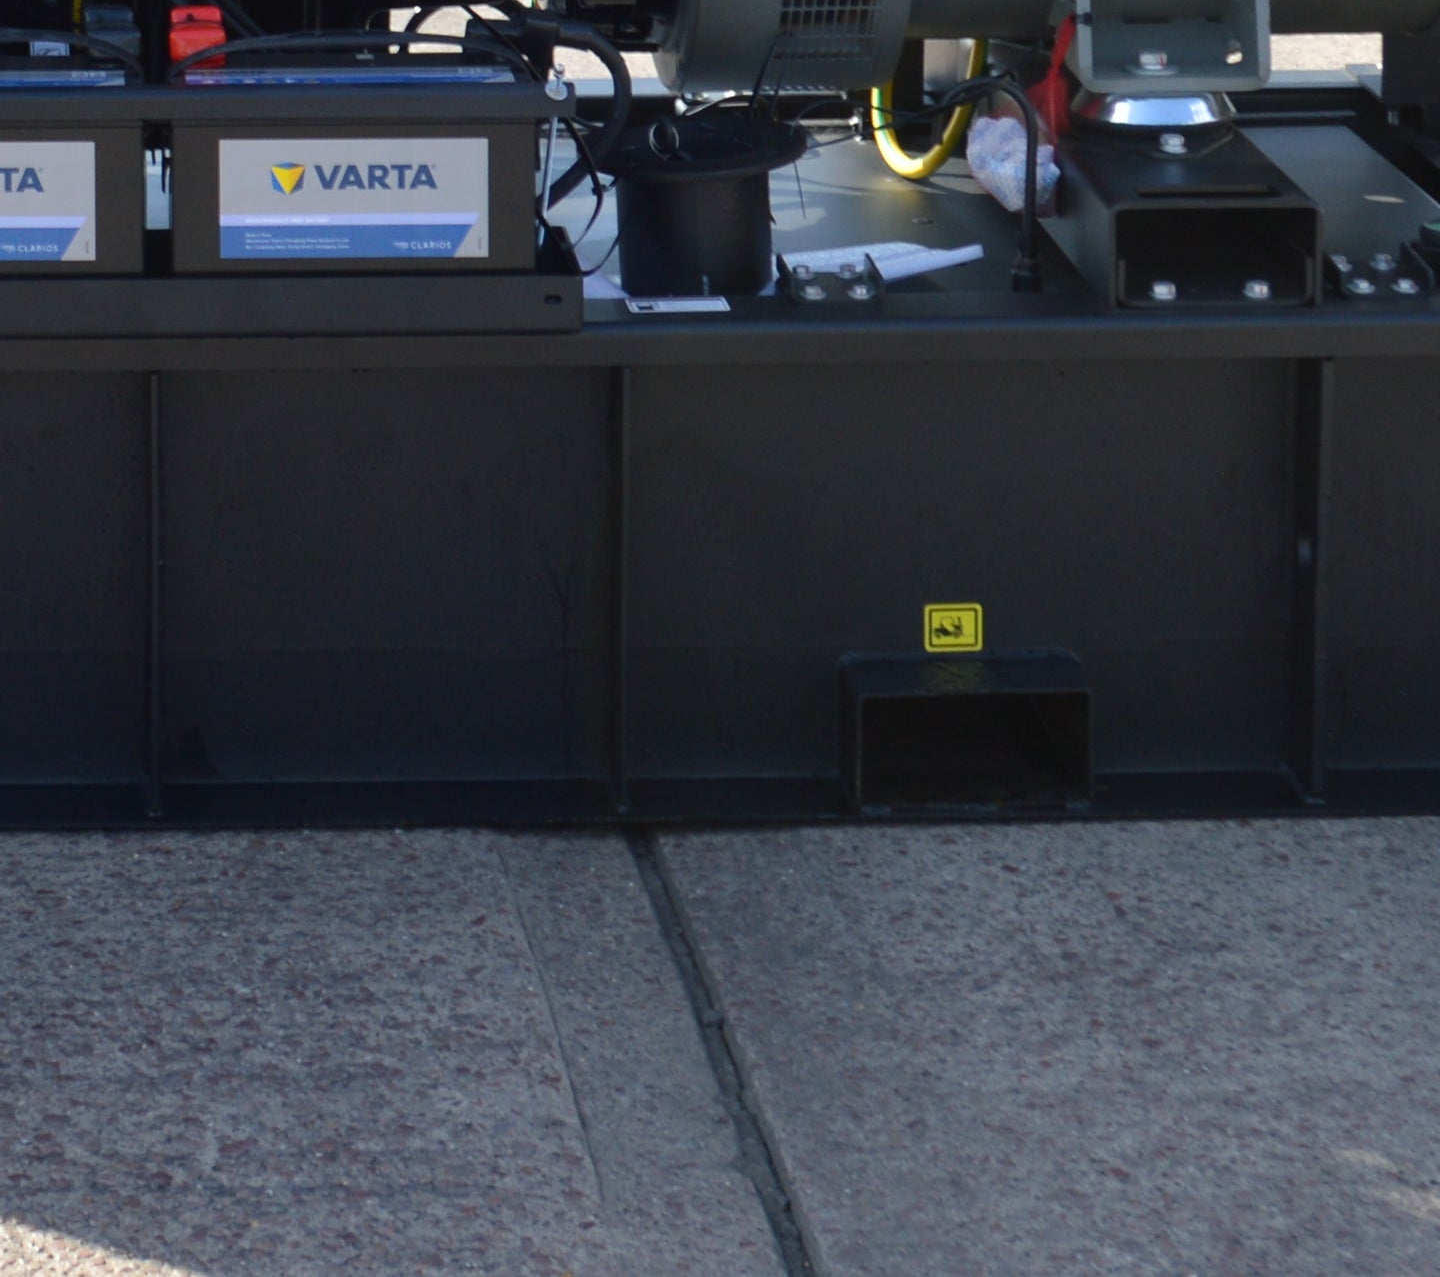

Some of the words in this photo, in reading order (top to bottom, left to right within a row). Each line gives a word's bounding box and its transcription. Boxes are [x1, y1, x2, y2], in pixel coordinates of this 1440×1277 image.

[314, 164, 438, 190] VARTA
[18, 244, 58, 253] CLARIOS
[411, 241, 452, 250] CLARIOS
